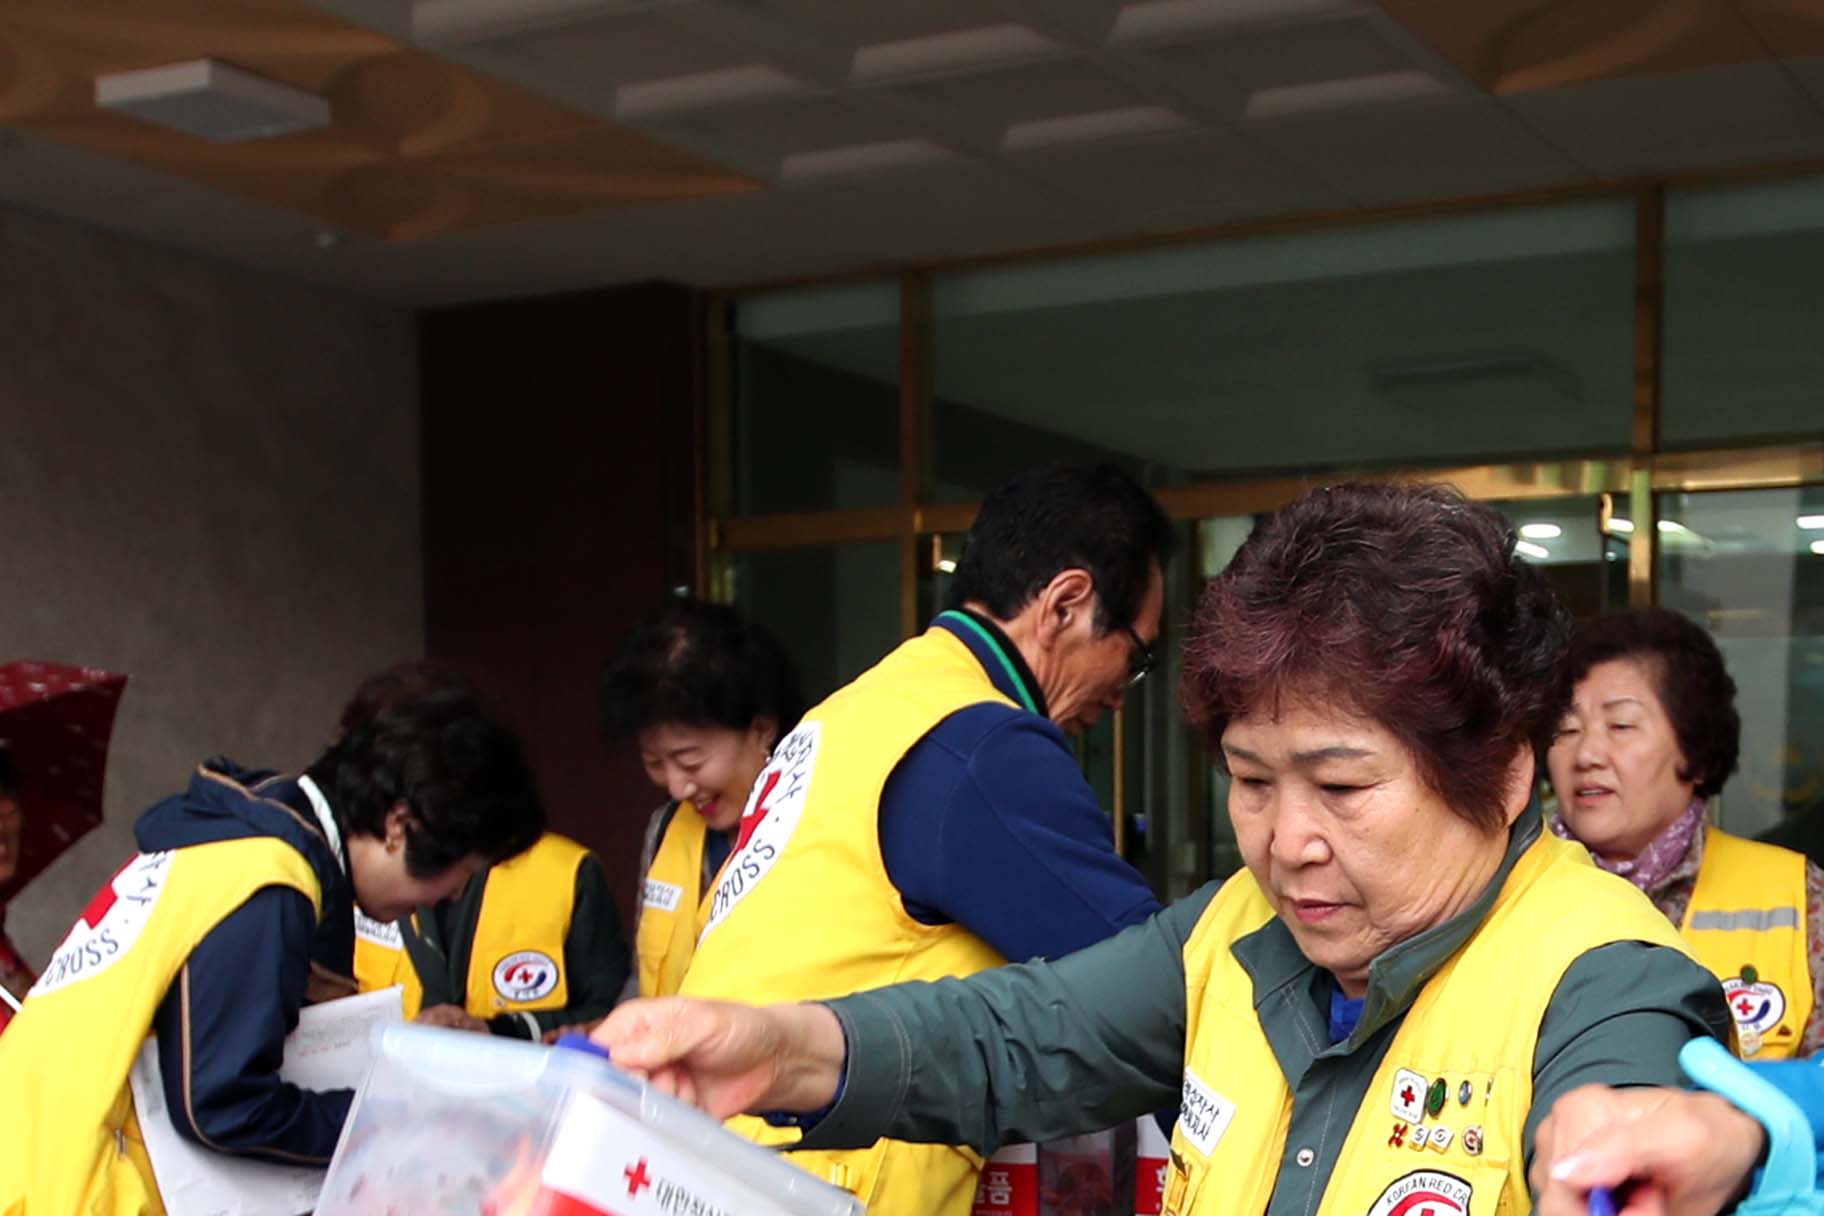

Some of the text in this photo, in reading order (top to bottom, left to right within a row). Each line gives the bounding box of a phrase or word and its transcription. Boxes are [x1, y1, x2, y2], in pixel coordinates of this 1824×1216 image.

[709, 838, 776, 922] CROSS
[1386, 1176, 1427, 1207] KOREAN
[1428, 1178, 1453, 1195] RED
